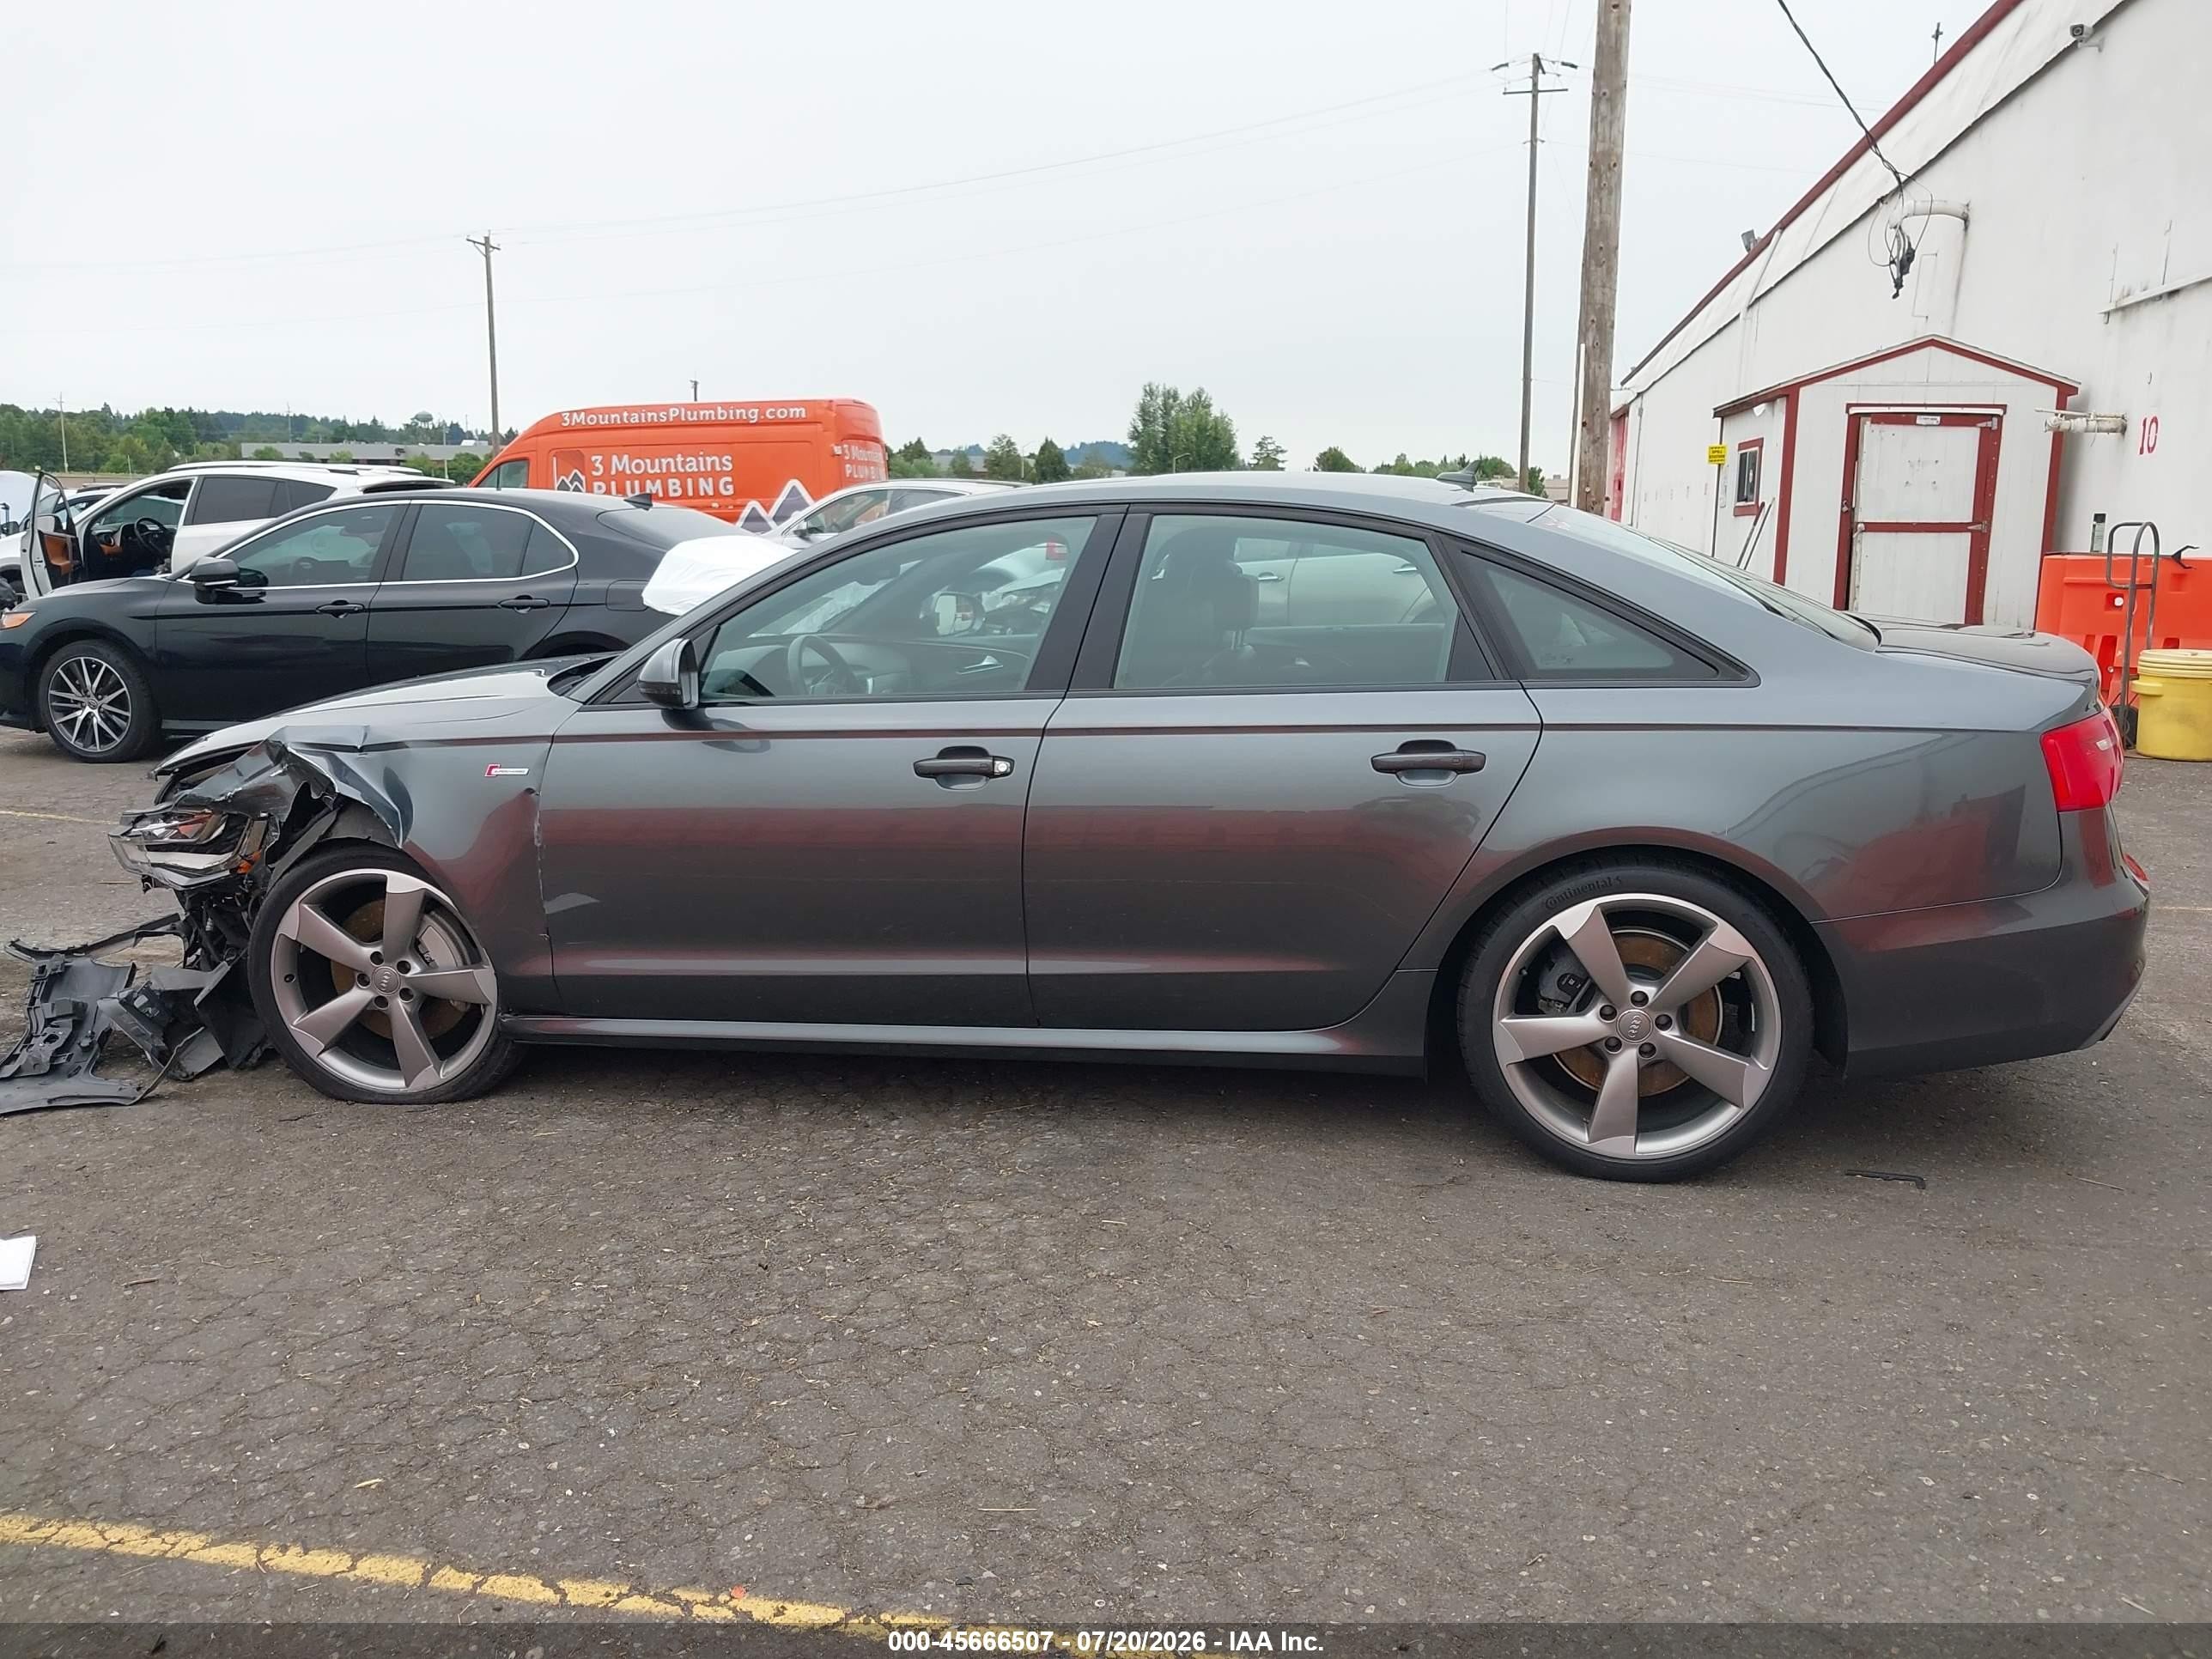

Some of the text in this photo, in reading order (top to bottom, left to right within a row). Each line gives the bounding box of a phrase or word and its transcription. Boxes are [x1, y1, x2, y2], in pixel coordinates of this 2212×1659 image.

[562, 406, 806, 427] 3MountainsPlumbing.com
[2139, 416, 2159, 455] 10
[591, 452, 733, 476] 3 Mountains
[592, 477, 735, 497] PLUMBING
[1546, 876, 1613, 909] Continental
